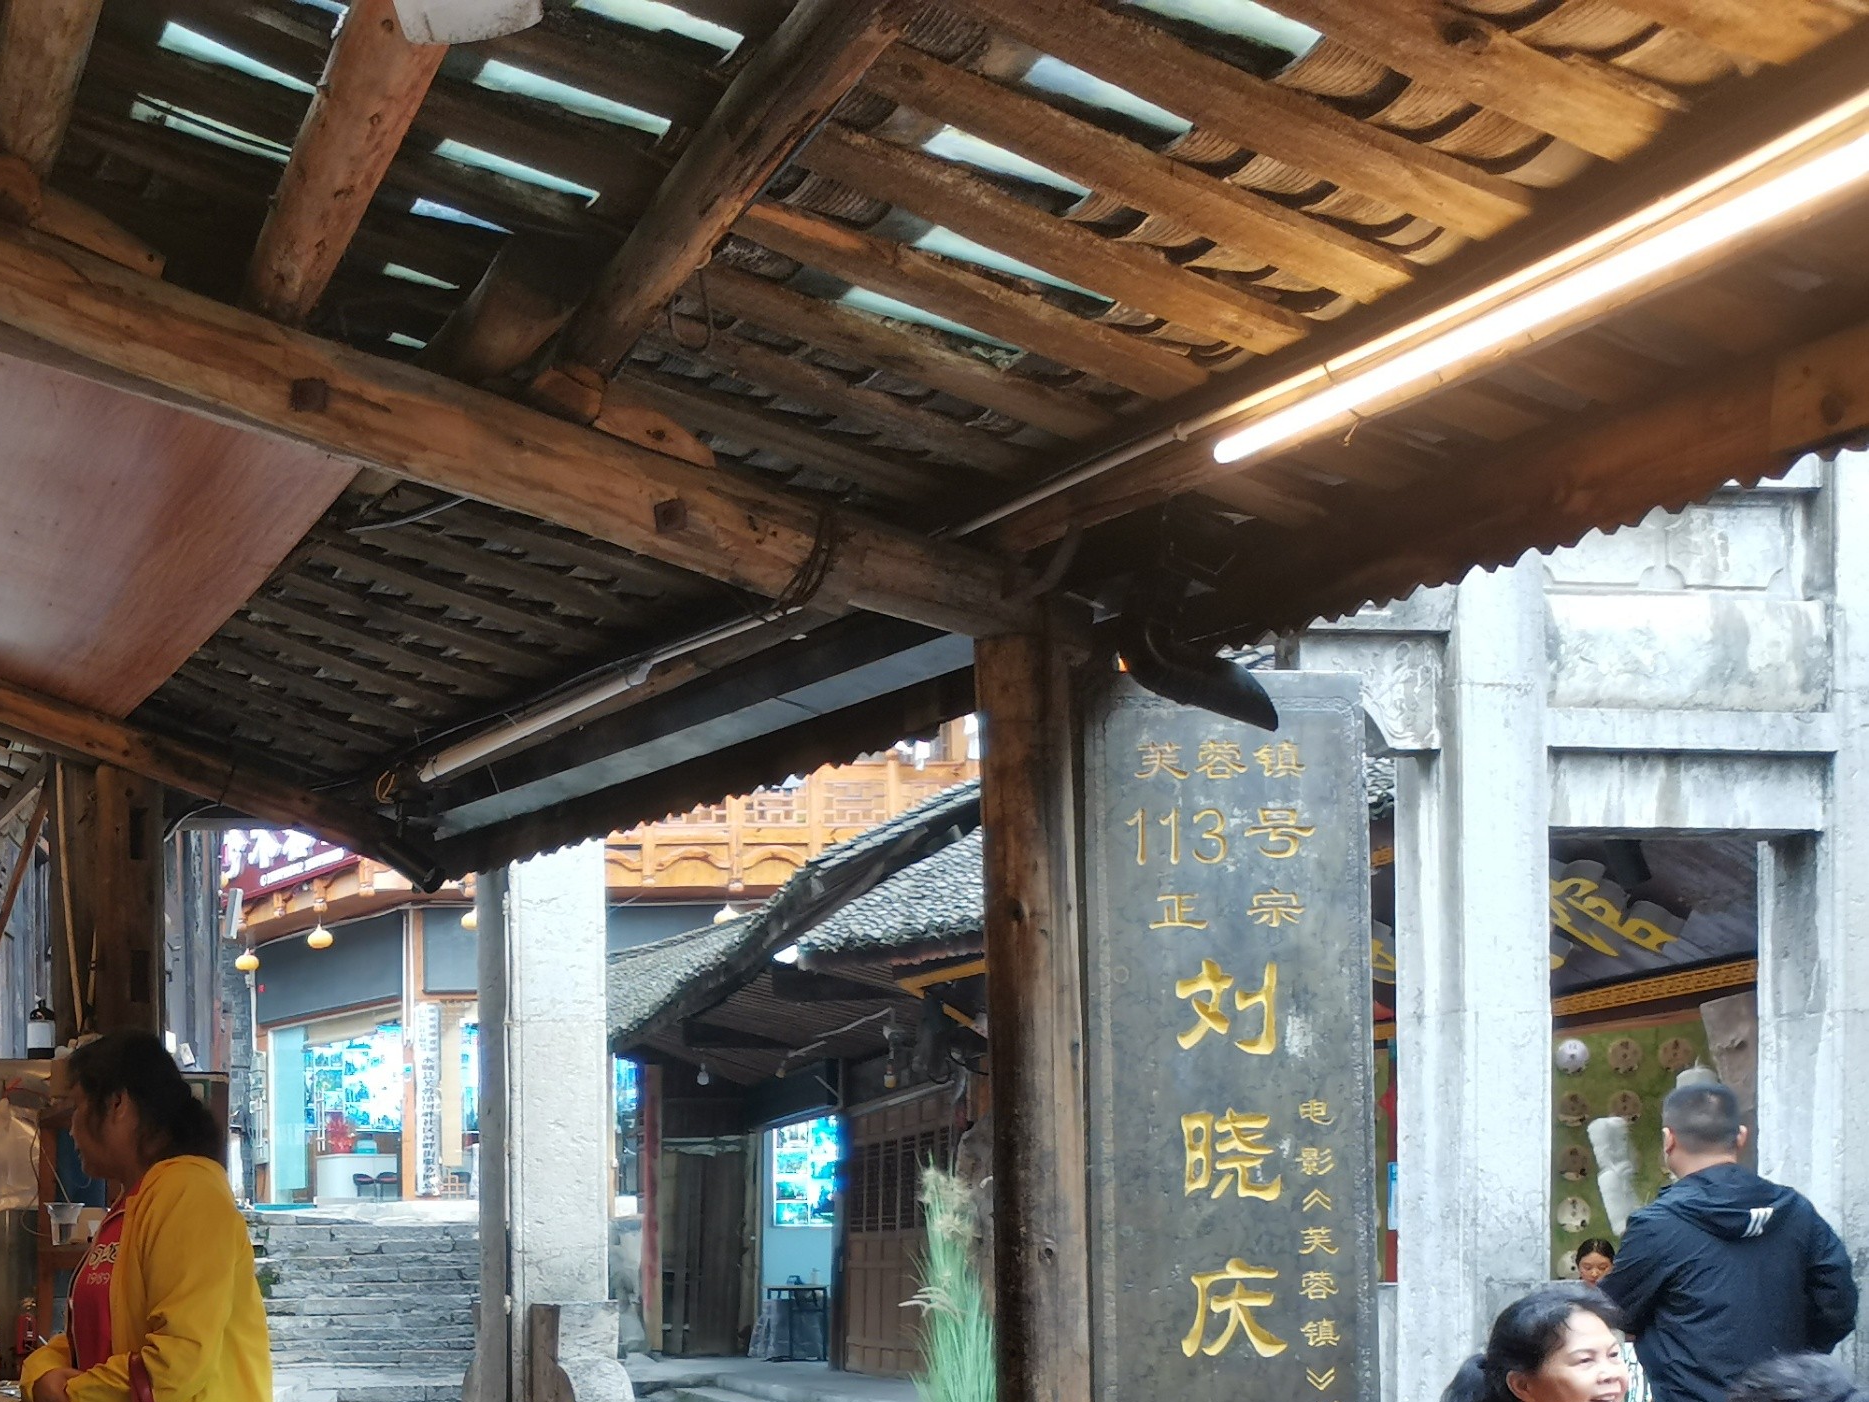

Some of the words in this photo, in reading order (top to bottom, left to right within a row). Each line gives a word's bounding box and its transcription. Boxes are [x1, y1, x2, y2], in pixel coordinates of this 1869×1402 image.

[1135, 742, 1306, 780] 芙蓉镇
[1126, 806, 1316, 866] 113号
[1149, 888, 1305, 930] 正宗
